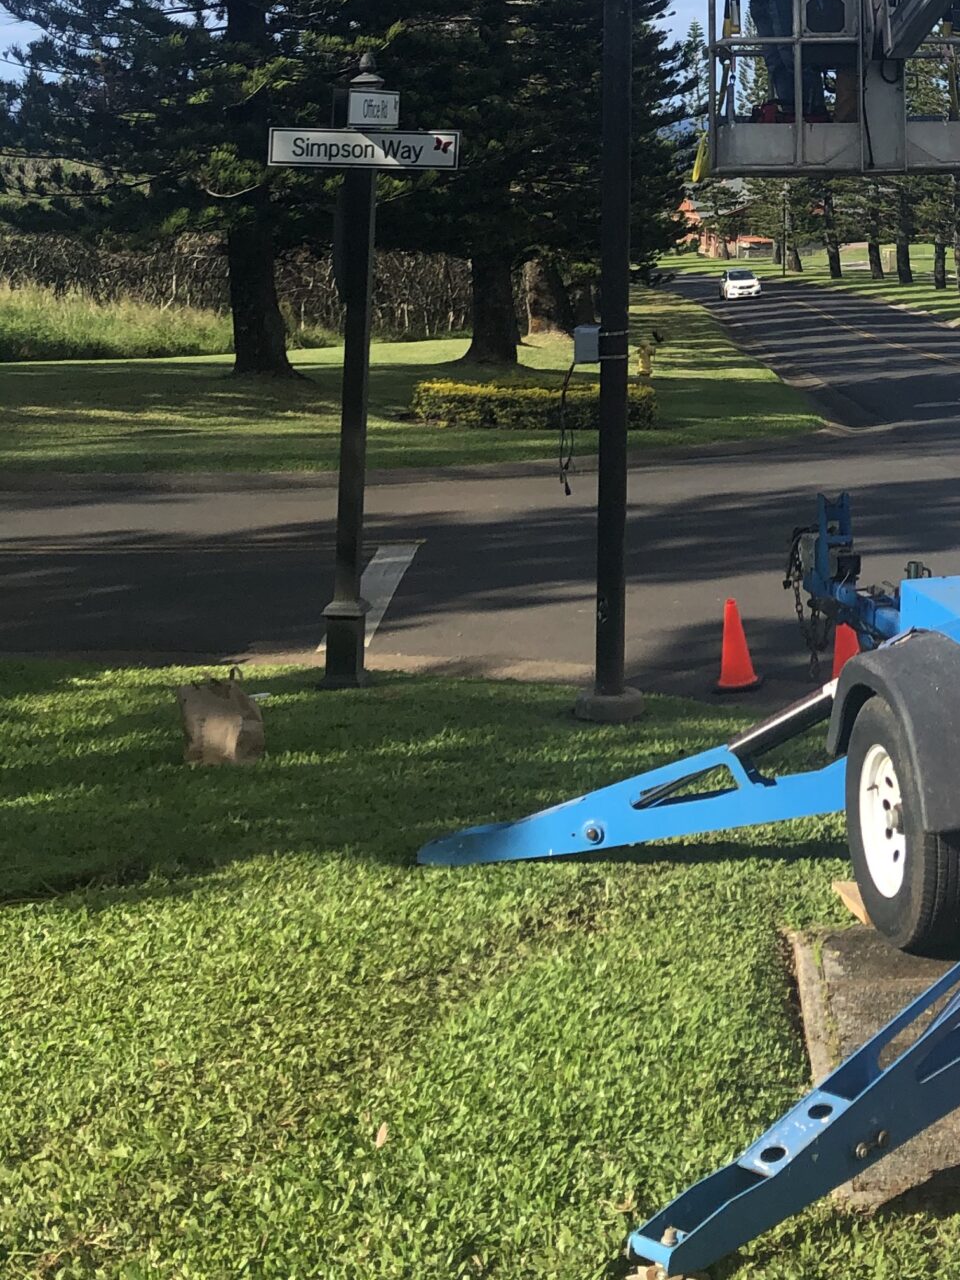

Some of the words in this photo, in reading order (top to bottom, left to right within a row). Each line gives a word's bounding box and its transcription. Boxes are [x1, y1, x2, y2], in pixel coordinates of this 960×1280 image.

[363, 98, 380, 119] Office
[381, 100, 388, 119] Rd
[291, 137, 375, 161] Simpson
[382, 140, 424, 163] Way
